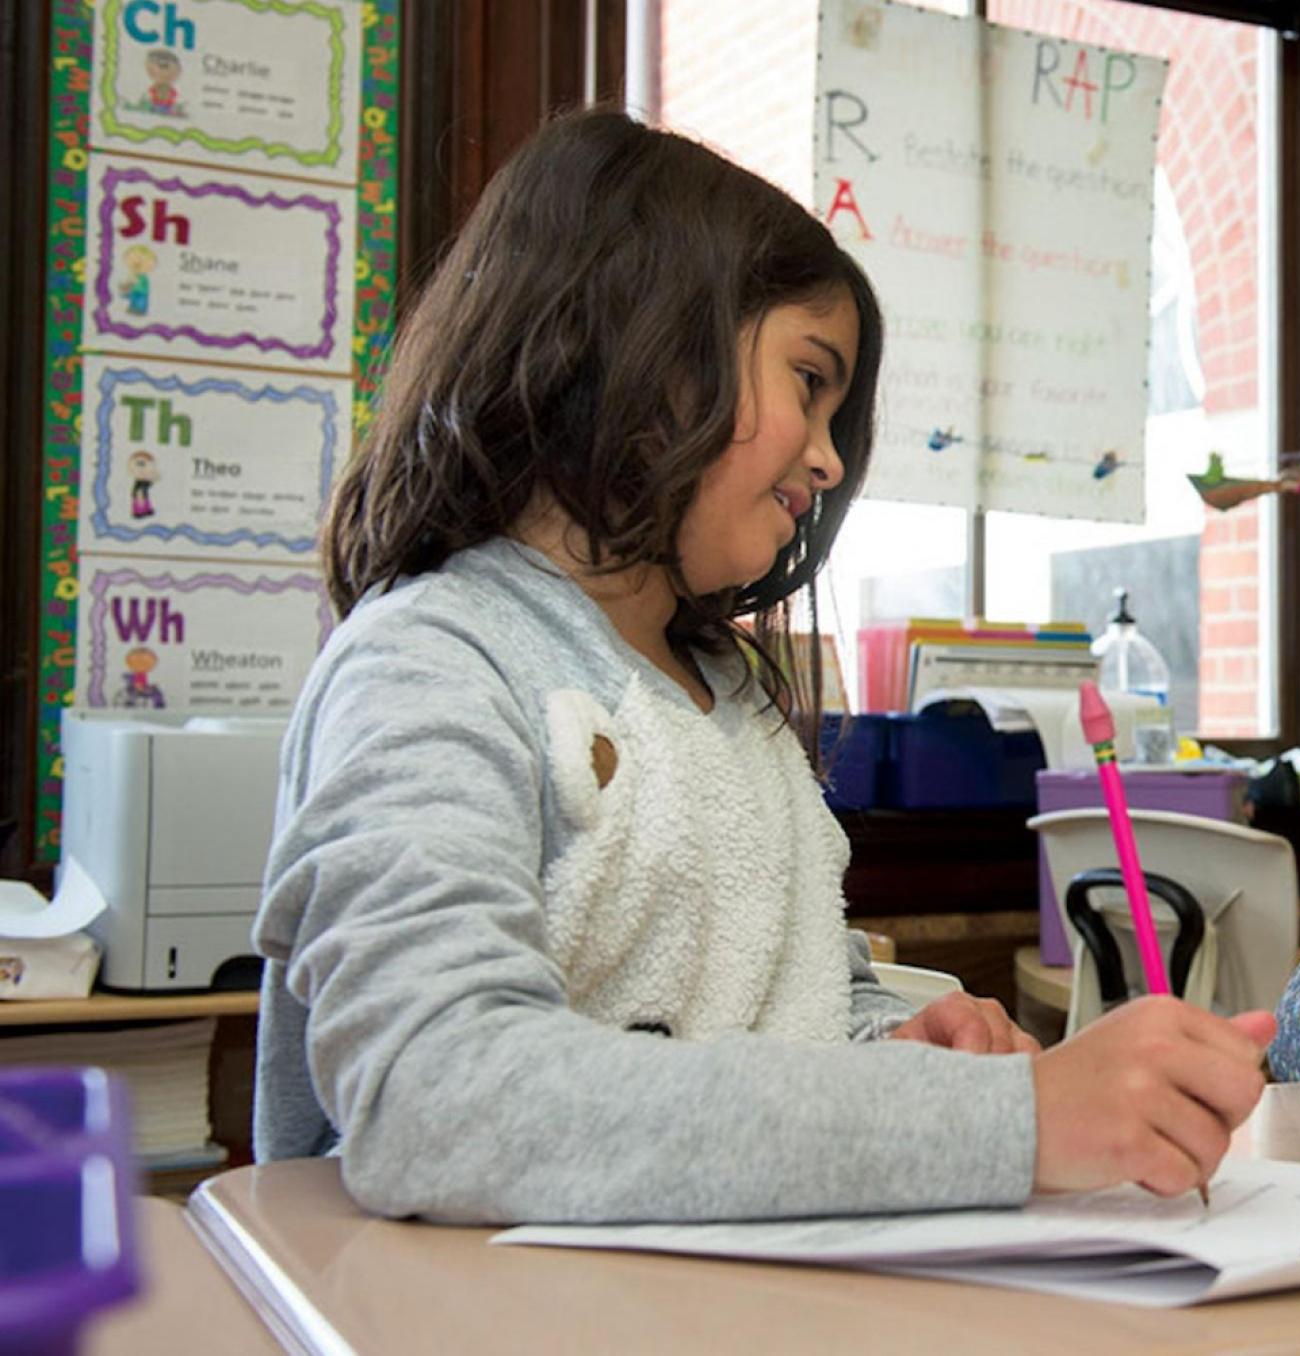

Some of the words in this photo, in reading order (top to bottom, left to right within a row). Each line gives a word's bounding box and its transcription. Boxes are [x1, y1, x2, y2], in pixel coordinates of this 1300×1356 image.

[123, 0, 196, 50] Ch
[202, 52, 272, 77] Charlie
[1032, 39, 1137, 124] RAP
[825, 88, 879, 163] R
[118, 195, 192, 246] Sh
[826, 176, 876, 241] A
[178, 252, 241, 273] Shane
[121, 396, 193, 447] Th
[191, 457, 243, 480] Theo
[111, 596, 185, 645] Wh
[189, 648, 284, 672] Wheaton
